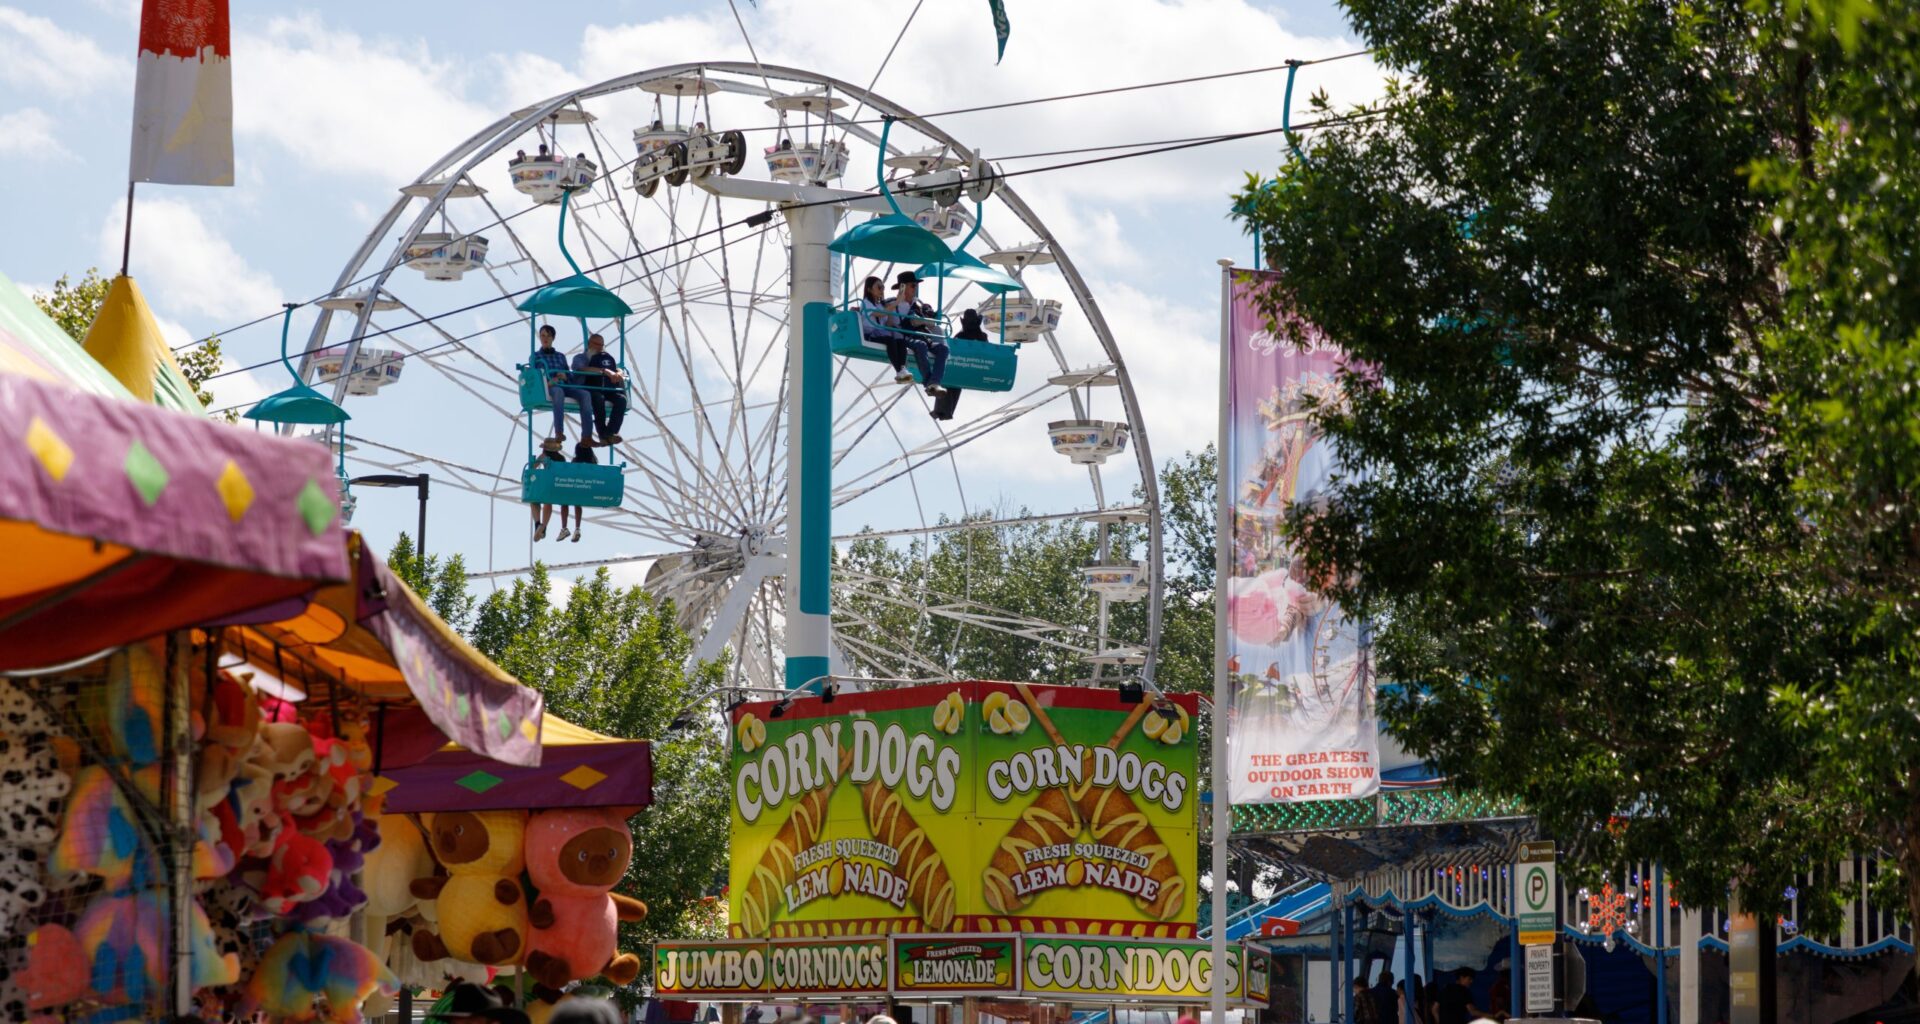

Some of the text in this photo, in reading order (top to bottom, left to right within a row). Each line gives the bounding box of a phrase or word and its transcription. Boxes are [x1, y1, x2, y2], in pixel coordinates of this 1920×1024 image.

[736, 719, 960, 822] CORN DOGS
[1250, 751, 1369, 767] THE GREATEST
[987, 744, 1187, 810] CORN DOGS
[1248, 767, 1374, 783] OUTDOOR SHOW
[1270, 783, 1352, 798] ON EARTH
[793, 838, 899, 871] FRESH SQUEEZED
[1023, 843, 1150, 869] FRESH SQUEEZED
[926, 945, 982, 958] FRESH SQUEEZED
[1530, 948, 1548, 959] PRIVATE
[660, 946, 883, 988] JUMBO CORNDOGS
[914, 959, 996, 983] LEMONADE
[1027, 943, 1240, 994] CORNDOGS
[1528, 960, 1550, 970] PROPERTY
